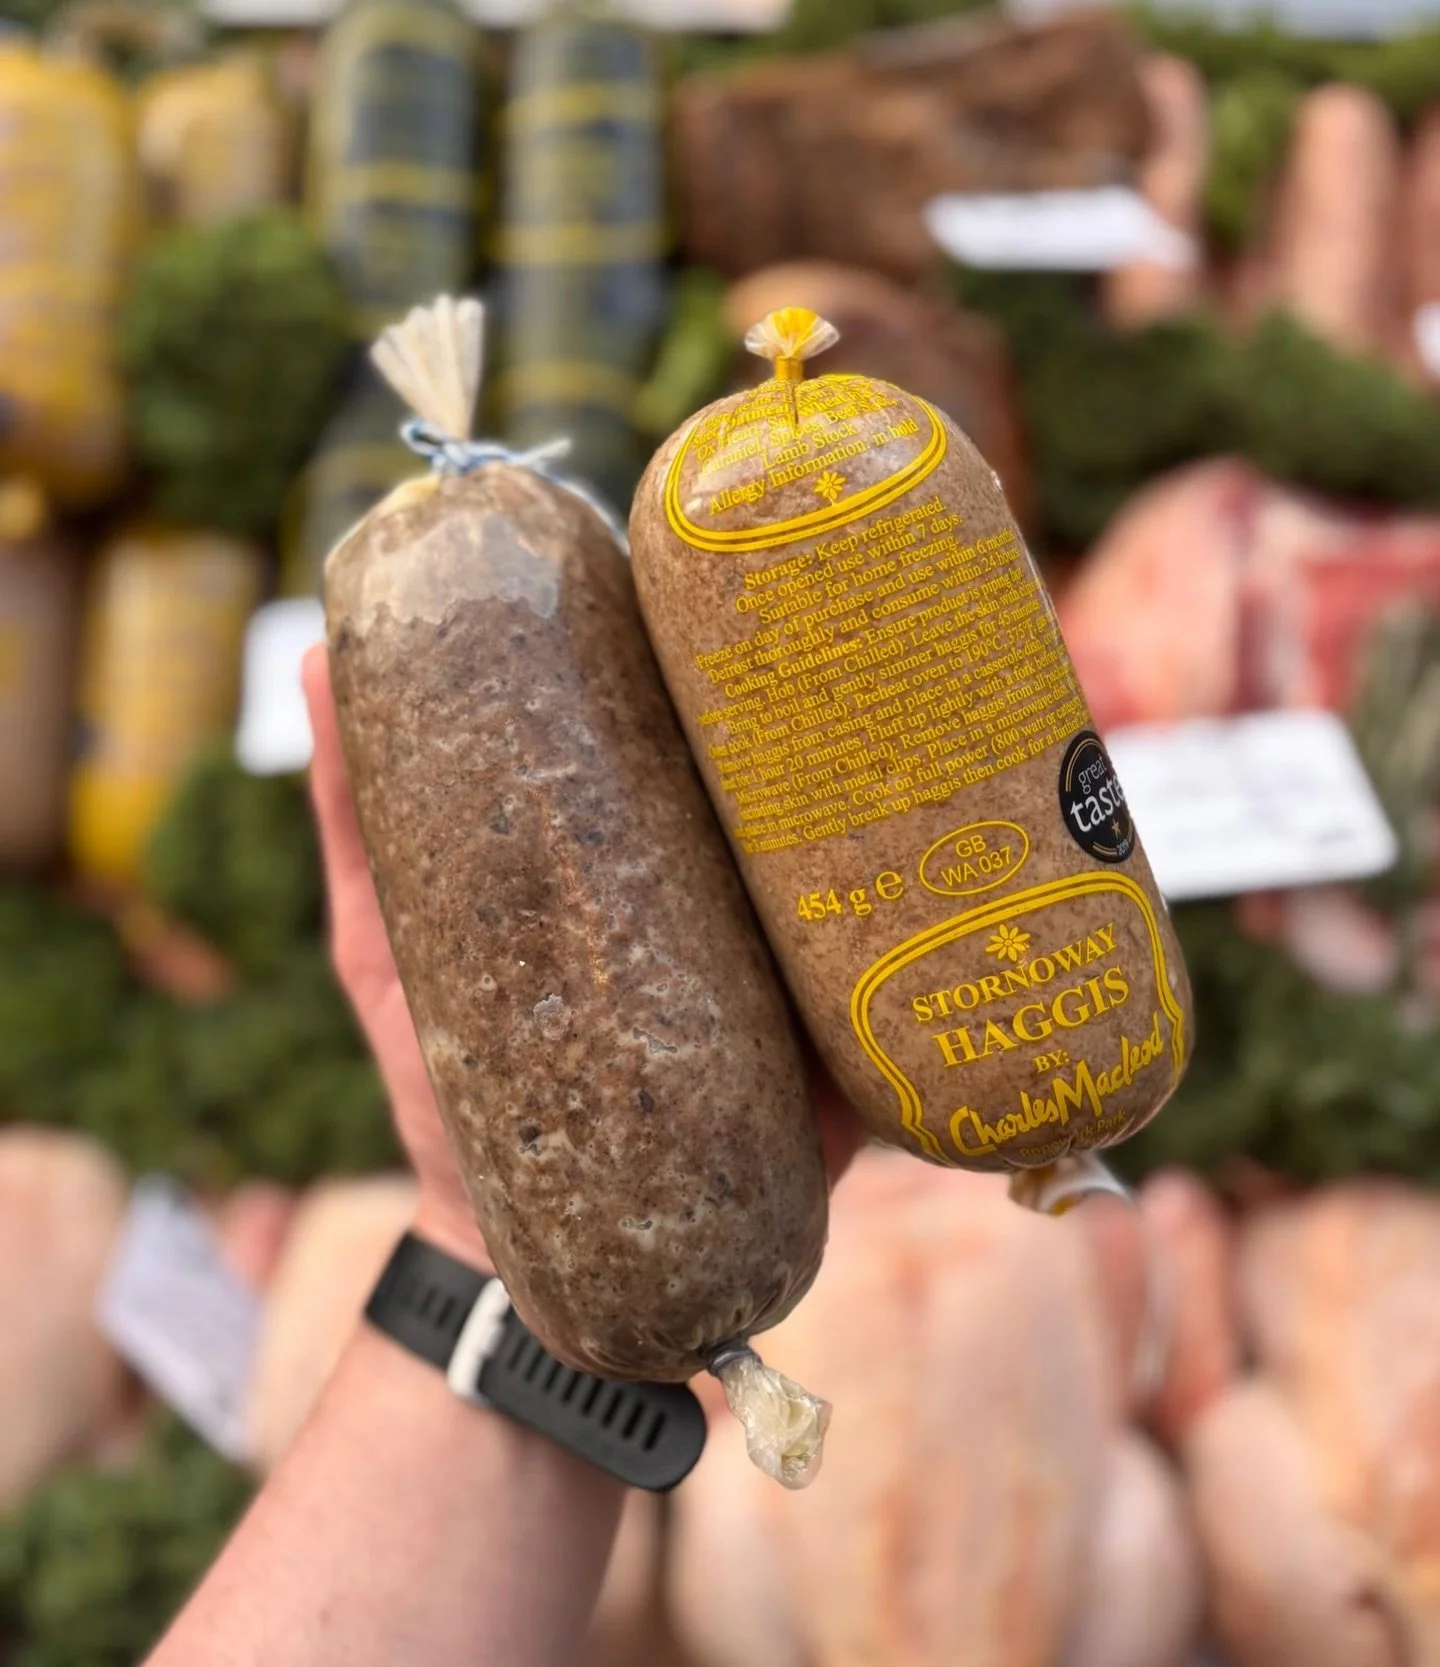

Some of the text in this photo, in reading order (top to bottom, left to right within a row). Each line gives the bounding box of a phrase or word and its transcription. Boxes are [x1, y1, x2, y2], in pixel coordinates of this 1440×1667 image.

[710, 480, 765, 515] Allergy
[871, 432, 889, 446] in
[761, 441, 809, 469] Lamb
[736, 514, 963, 612] Once opened use within 7 days.
[745, 497, 946, 589] Storage: Keep refrigerated.
[759, 536, 958, 624] Suitable for home freezing.
[695, 647, 733, 669] Freeze
[734, 640, 752, 655] on
[754, 628, 779, 646] day
[784, 615, 800, 635] of
[803, 591, 873, 631] purchase
[877, 573, 906, 597] and
[908, 565, 934, 583] use
[936, 546, 976, 571] within
[976, 539, 986, 554] 6
[708, 658, 753, 683] Defrost
[755, 626, 834, 665] thoroughly
[839, 609, 869, 633] and
[872, 584, 939, 618] consume
[941, 563, 982, 588] within
[981, 554, 997, 572] 24
[723, 696, 766, 718] serving.
[765, 682, 795, 702] Hob
[797, 667, 842, 693] (From
[844, 638, 908, 672] Chilled):
[910, 621, 954, 646] Leave
[954, 610, 975, 627] the
[975, 598, 1000, 617] skin
[999, 586, 1020, 605] with
[725, 672, 778, 698] Cooking
[778, 639, 862, 677] Guidelines:
[864, 616, 916, 645] Ensure
[918, 592, 968, 626] product
[967, 585, 980, 600] is
[981, 574, 1012, 598] piping
[727, 717, 760, 734] Bring
[759, 712, 773, 724] to
[772, 698, 801, 718] boil
[802, 687, 829, 708] and
[831, 672, 875, 701] gently
[879, 649, 932, 679] simmer
[933, 629, 978, 656] haggis
[978, 620, 996, 636] for
[998, 610, 1011, 627] 45
[728, 734, 752, 754] cook
[752, 725, 790, 748] (From
[791, 700, 852, 731] Chilled):
[854, 678, 910, 708] Preheat
[912, 664, 947, 685] oven
[948, 657, 963, 670] to
[751, 742, 790, 764] haggis
[791, 732, 825, 751] from
[827, 714, 874, 738] casing
[875, 698, 903, 720] and
[905, 685, 944, 713] place
[944, 677, 960, 692] in
[962, 673, 972, 685] a
[973, 648, 1024, 679] casserole
[757, 764, 785, 781] hour
[786, 754, 804, 772] 20
[806, 737, 865, 765] minutes.
[867, 716, 905, 743] Fluff
[907, 712, 927, 728] up
[928, 691, 973, 719] lightly
[976, 676, 1004, 697] with
[1005, 673, 1014, 685] a
[1013, 660, 1036, 680] fork
[736, 782, 790, 803] Microwave
[791, 767, 833, 791] (From
[835, 741, 898, 773] Chilled):
[900, 718, 961, 749] Remove
[961, 697, 1005, 724] haggis
[1005, 685, 1033, 704] from
[1033, 673, 1046, 691] all
[739, 694, 1053, 820] cluding skin with metal clips. Place in a microwave
[765, 819, 778, 831] in
[779, 801, 850, 829] microwave.
[852, 782, 892, 805] Cook
[894, 776, 914, 791] on
[916, 761, 943, 783] full
[945, 745, 988, 776] power
[991, 728, 1020, 755] (800
[1021, 717, 1045, 736] watt
[1045, 712, 1056, 725] or
[1078, 755, 1107, 795] great
[760, 833, 803, 850] minutes.
[803, 818, 851, 840] Gently
[848, 802, 889, 826] break
[891, 796, 911, 812] up
[912, 777, 961, 803] haggis
[963, 764, 994, 783] then
[996, 746, 1027, 769] cook
[1028, 739, 1045, 755] for
[1046, 734, 1054, 745] a
[1070, 775, 1125, 832] taste
[940, 847, 1011, 888] WA 037
[955, 834, 987, 859] GB
[797, 887, 873, 921] 454 g
[912, 923, 1117, 1023] STORNOWAY
[932, 965, 1130, 1068] HAGGIS
[1033, 1050, 1070, 1074] BY:
